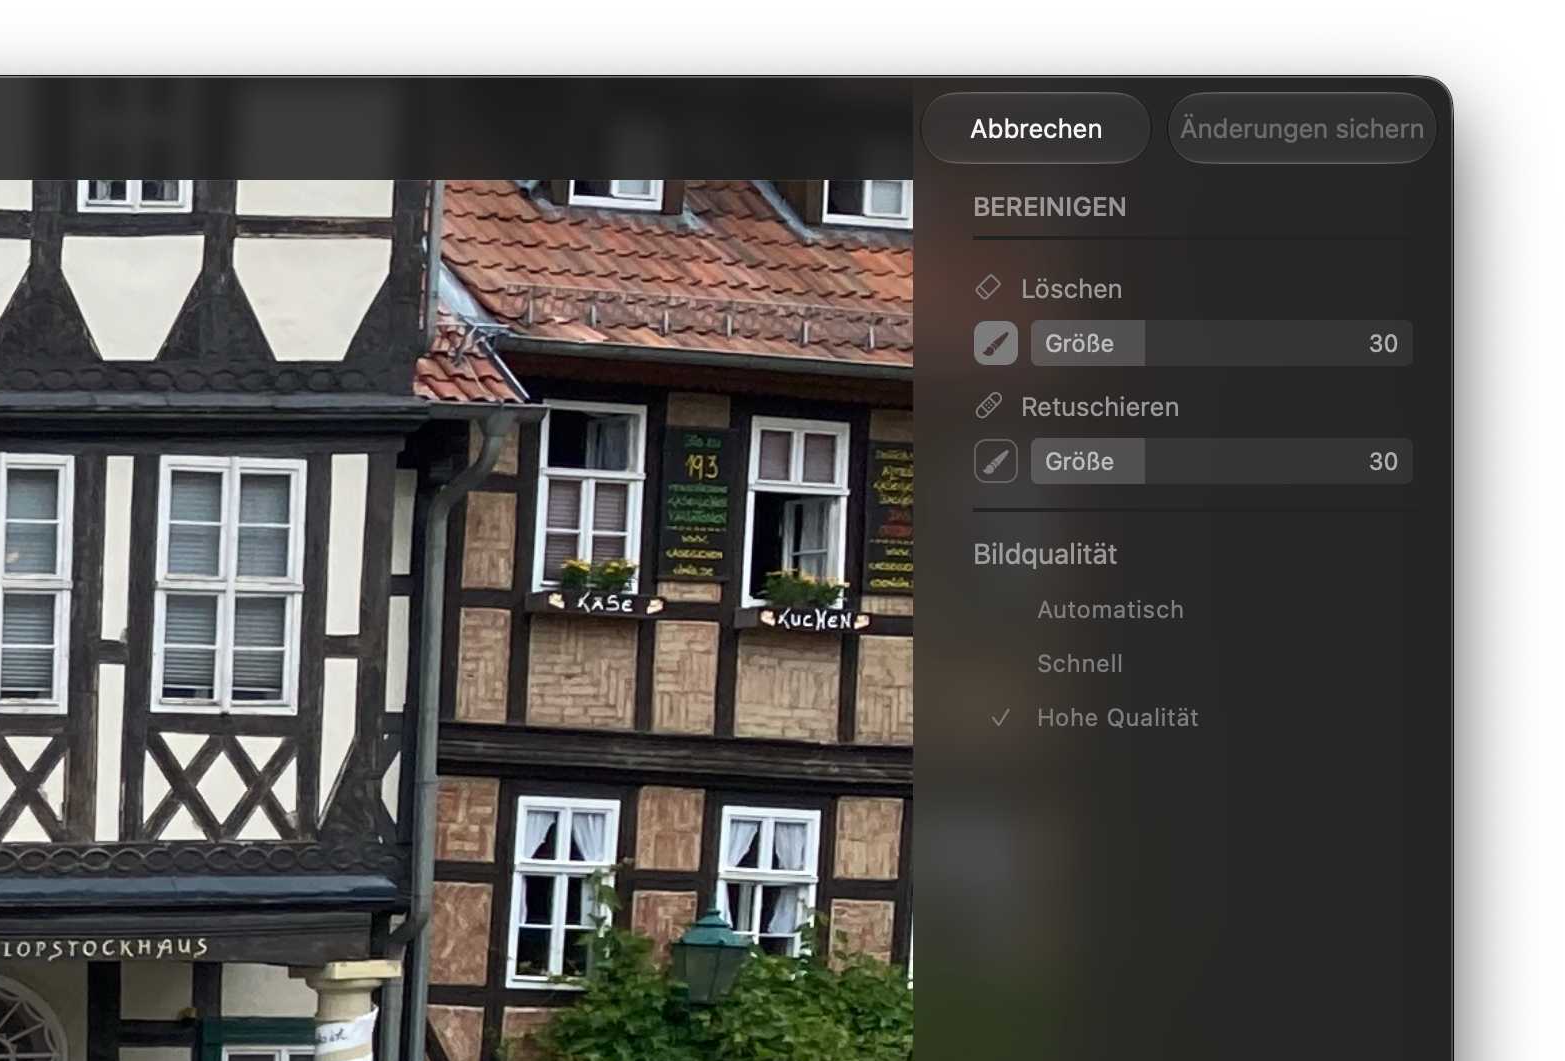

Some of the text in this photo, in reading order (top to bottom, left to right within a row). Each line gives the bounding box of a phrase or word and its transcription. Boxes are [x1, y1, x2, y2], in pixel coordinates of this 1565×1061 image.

[970, 117, 1103, 139] Abbrechen
[1180, 113, 1425, 144] Änderungen sichern
[973, 196, 1127, 218] BEREINIGEN
[1021, 277, 1123, 300] Löschen
[1044, 332, 1115, 354] Größe
[1368, 332, 1399, 354] 30
[1021, 395, 1180, 418] Retuschieren
[1044, 450, 1115, 472] Größe
[1368, 450, 1399, 472] 30
[973, 541, 1119, 571] Bildqualität
[1037, 598, 1184, 620] Automatisch
[1037, 652, 1123, 674] Schnell
[1037, 706, 1200, 730] Hohe Qualität
